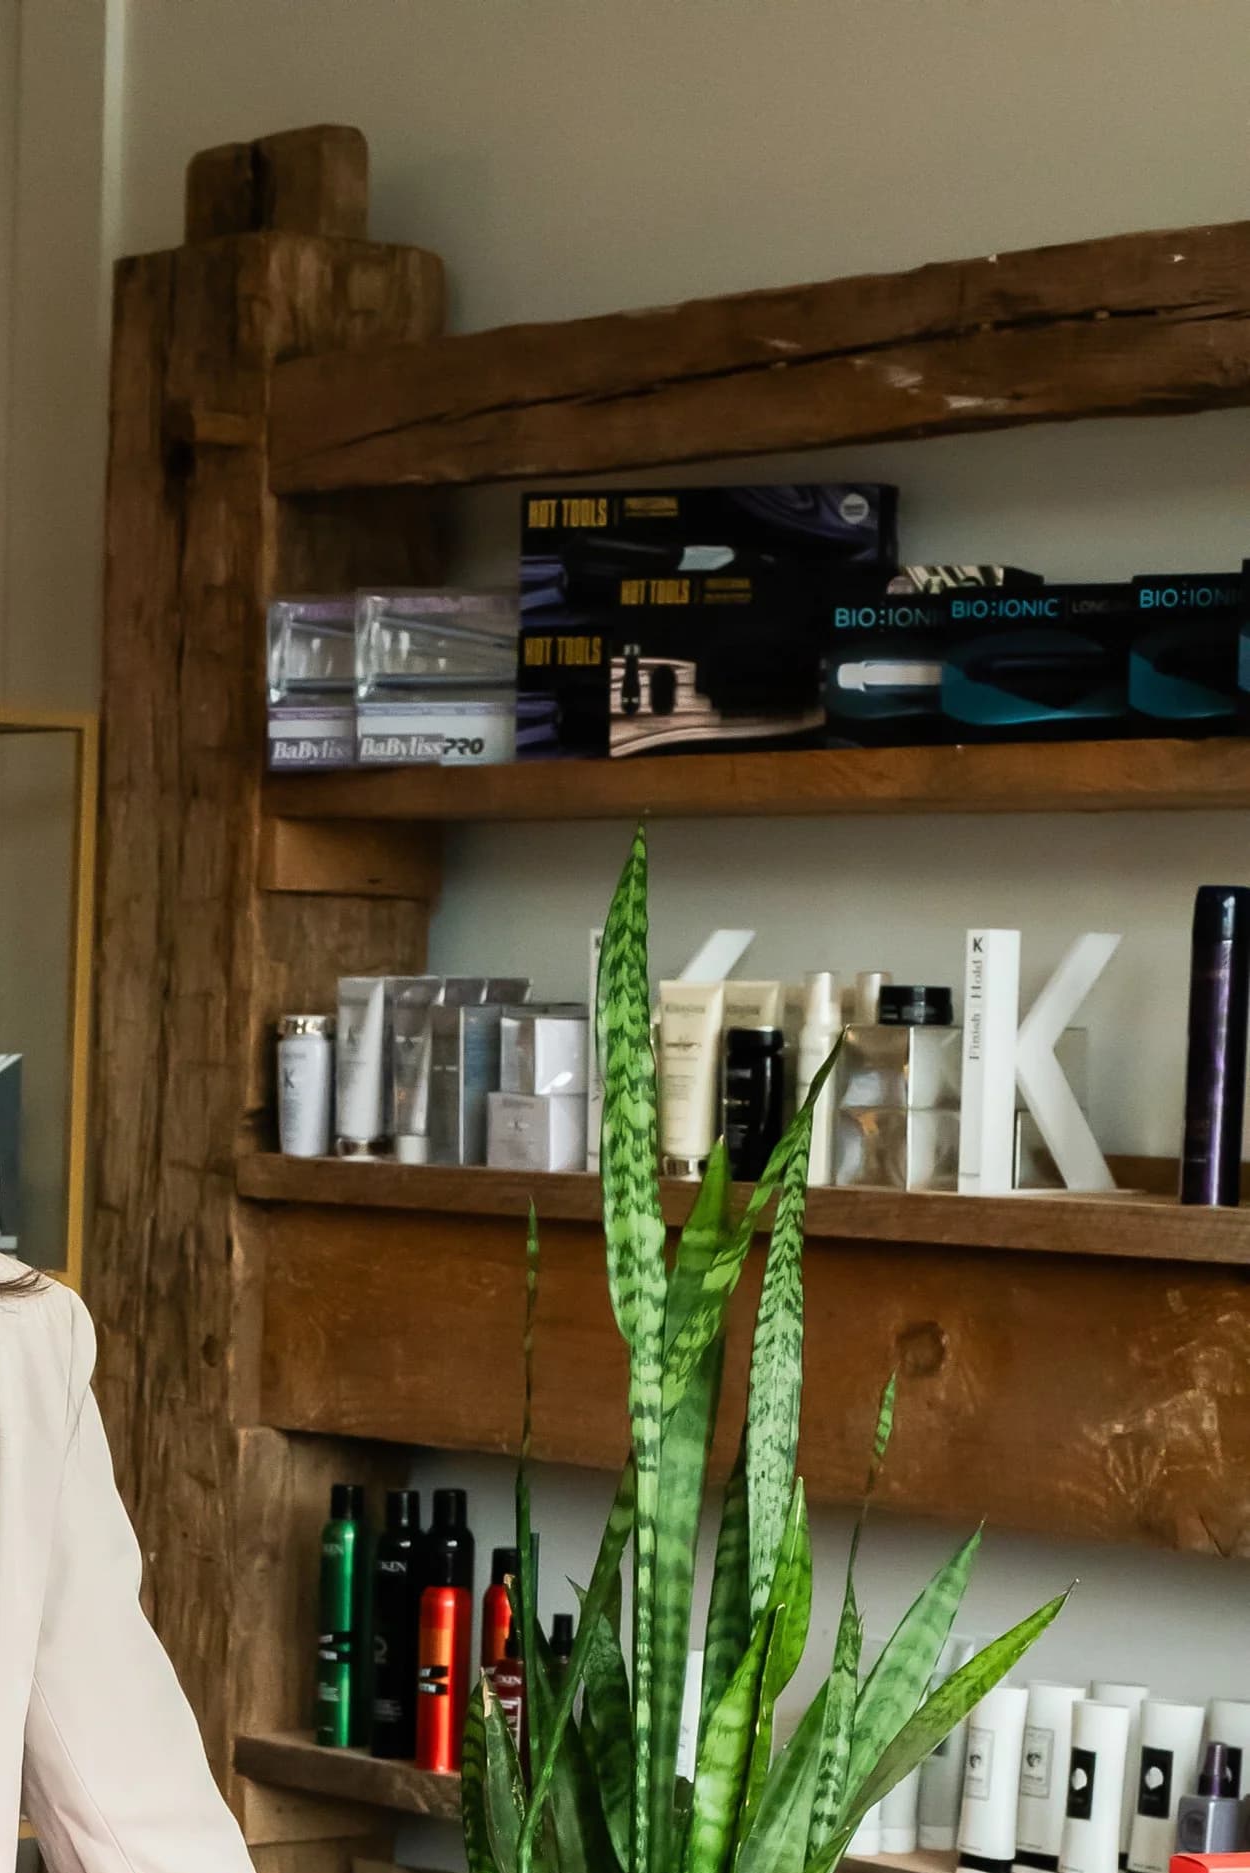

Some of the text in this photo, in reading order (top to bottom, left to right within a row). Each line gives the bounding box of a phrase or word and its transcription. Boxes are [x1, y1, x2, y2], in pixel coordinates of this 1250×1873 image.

[528, 499, 556, 528] HOT
[561, 497, 607, 528] TOOLS
[620, 579, 646, 604] HOT
[650, 578, 690, 604] TOOLS
[524, 636, 602, 665] HOT TOOLS
[972, 937, 983, 953] K
[969, 960, 983, 1060] Finish Hold
[282, 1066, 295, 1089] K
